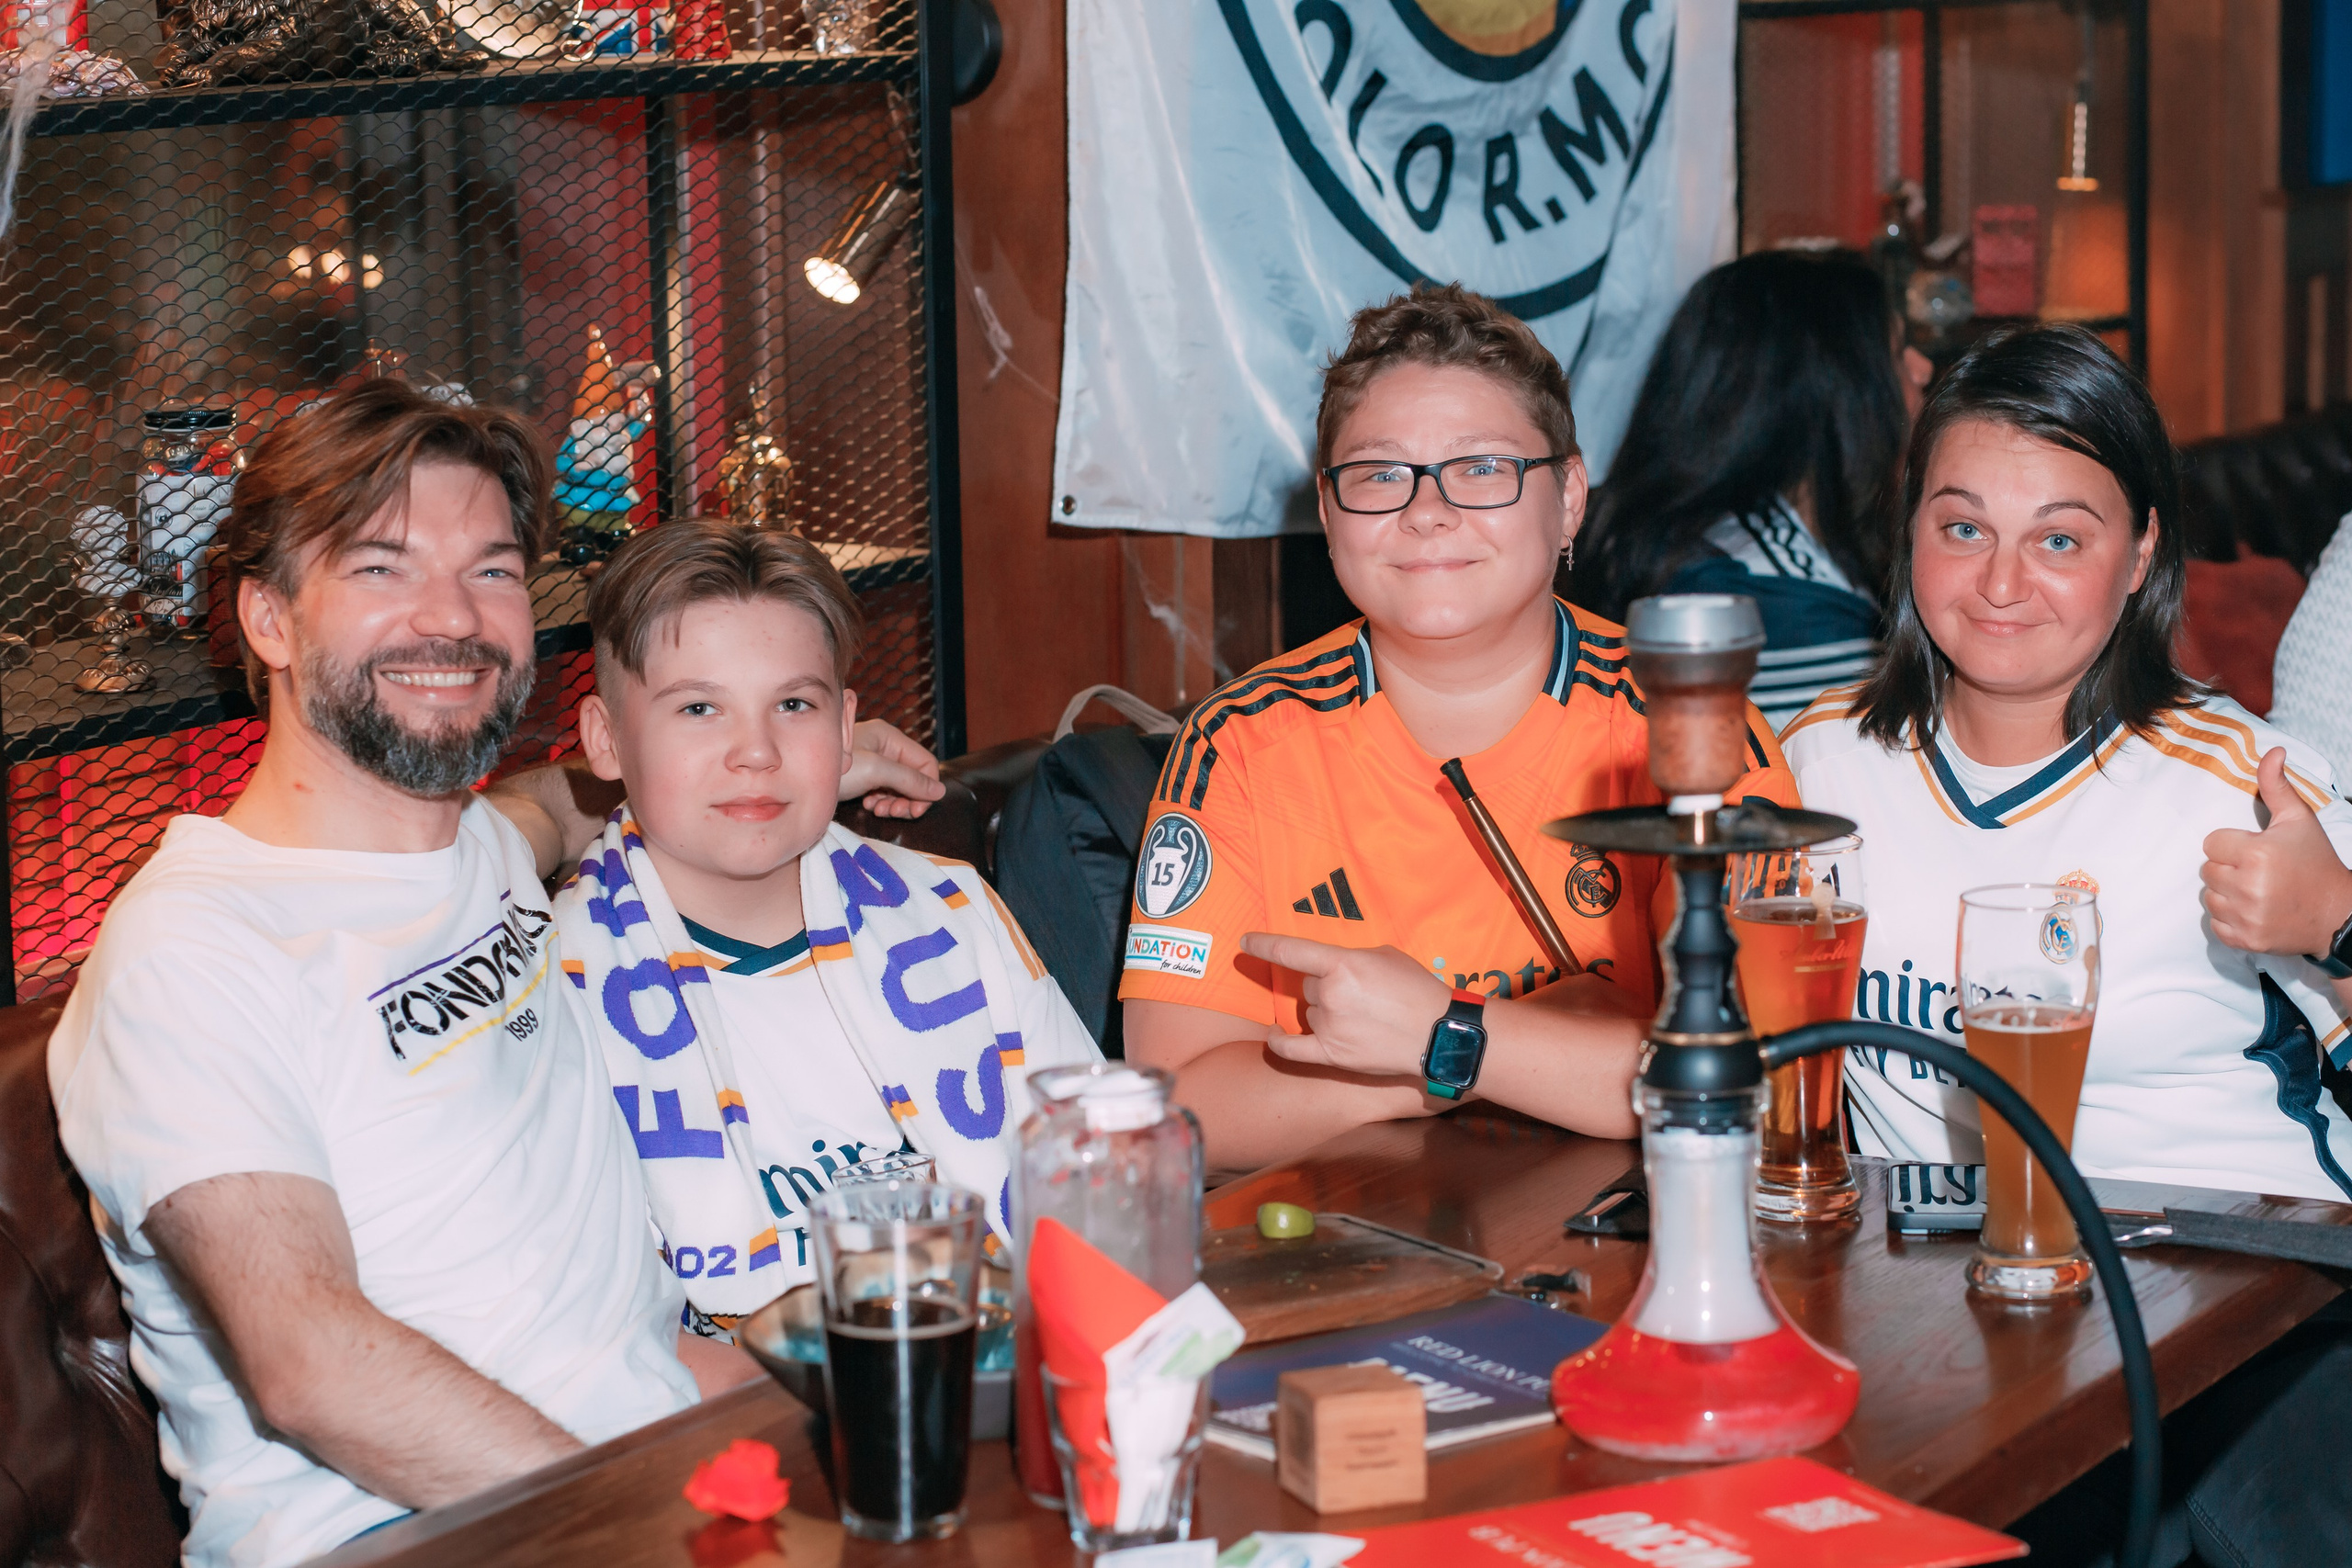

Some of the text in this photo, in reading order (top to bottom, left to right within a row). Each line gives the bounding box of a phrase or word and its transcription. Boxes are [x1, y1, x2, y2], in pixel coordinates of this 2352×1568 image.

[1151, 862, 1175, 886] 15
[1159, 959, 1202, 975] for children
[505, 1008, 539, 1042] 1999
[1408, 1336, 1464, 1359] RED
